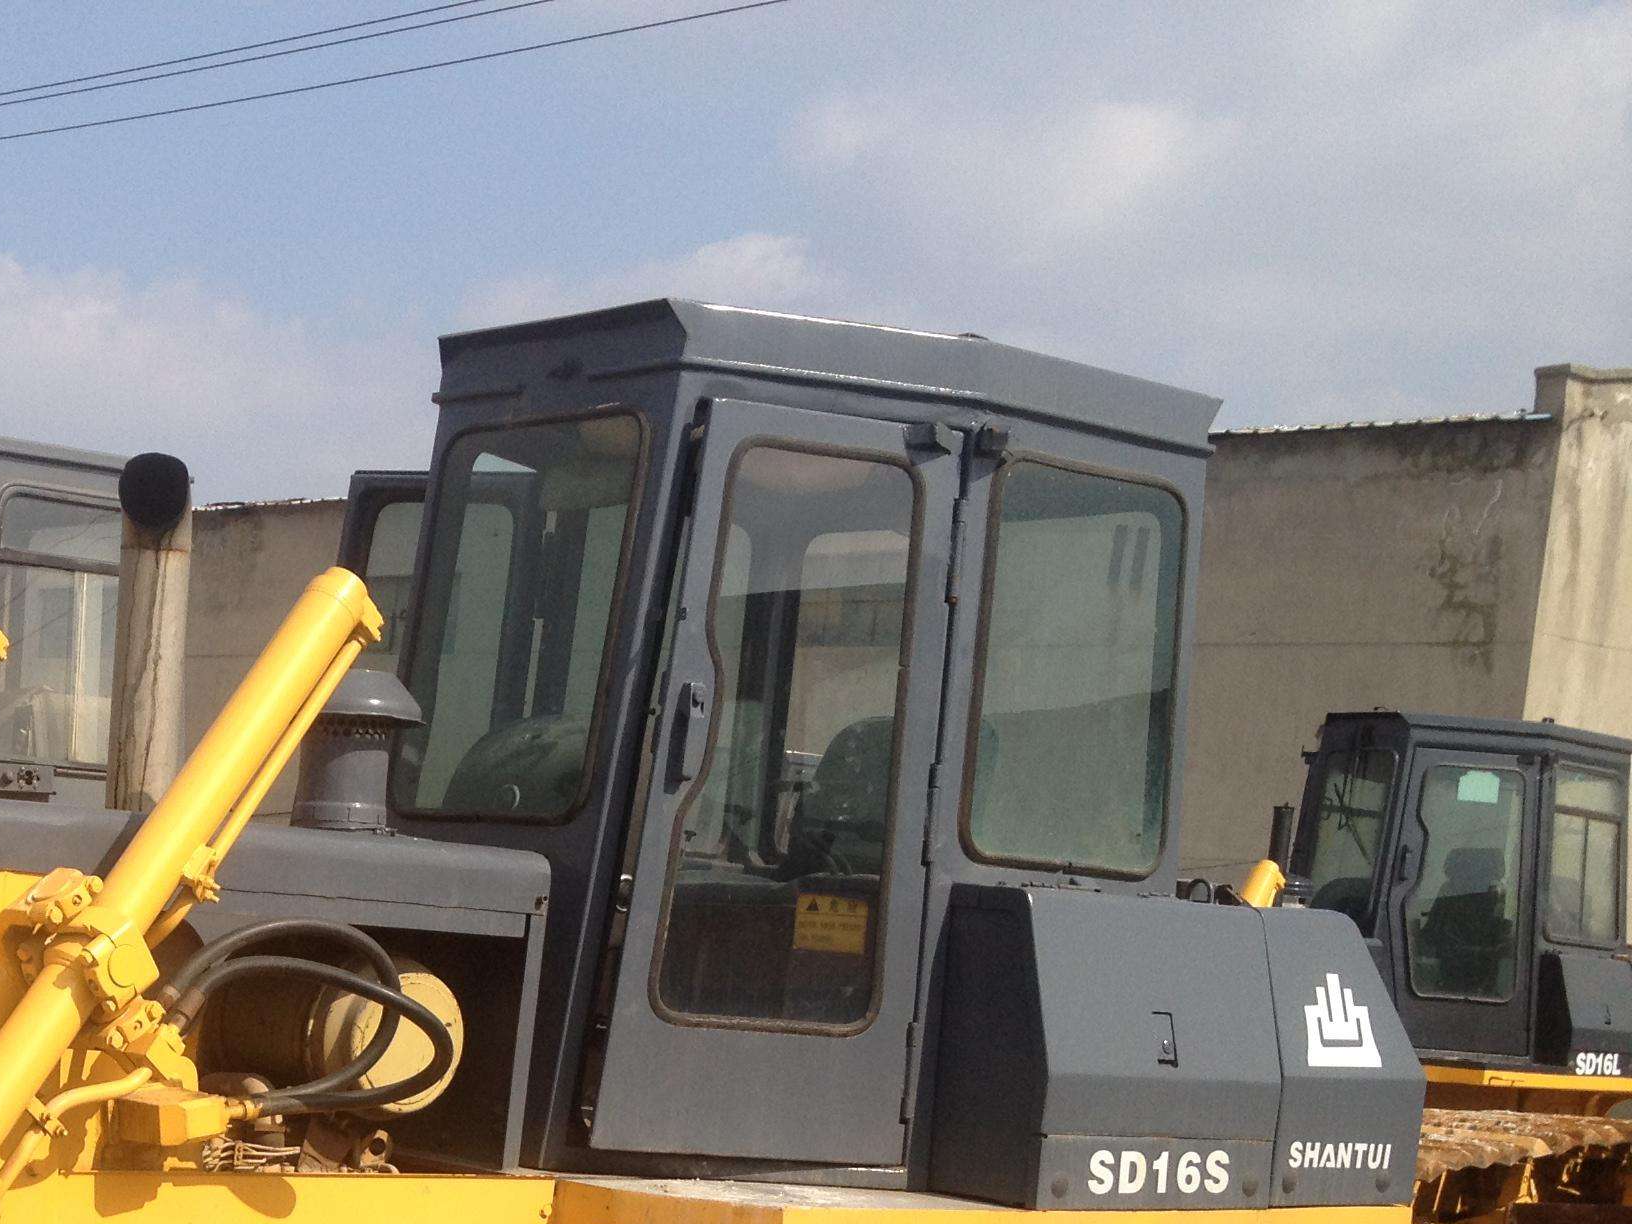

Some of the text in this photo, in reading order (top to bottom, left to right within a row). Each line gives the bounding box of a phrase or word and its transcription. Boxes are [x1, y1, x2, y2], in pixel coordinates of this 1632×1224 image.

[1575, 1052, 1621, 1076] SD16L
[1288, 1141, 1392, 1170] SHANTUI
[1087, 1149, 1230, 1195] SD16S
